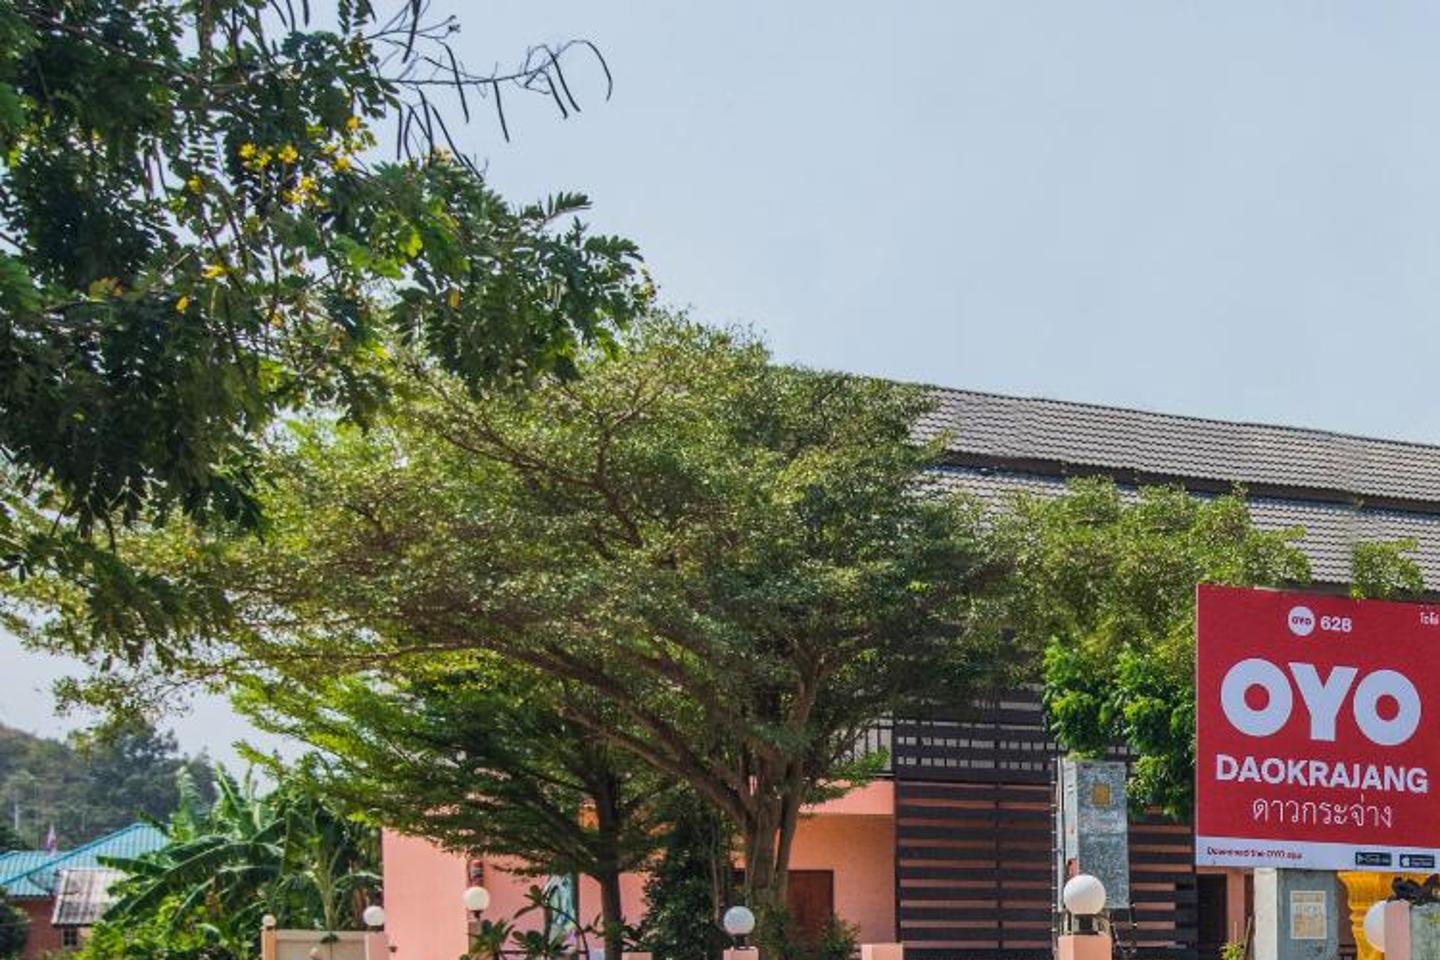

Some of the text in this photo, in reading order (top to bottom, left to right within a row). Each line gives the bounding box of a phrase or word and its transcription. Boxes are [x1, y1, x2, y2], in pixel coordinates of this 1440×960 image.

[1320, 616, 1352, 633] 628
[1221, 658, 1422, 746] OYO
[1215, 753, 1429, 793] DAOKRAJANG
[1252, 794, 1392, 828] ดาวกระจ่าง
